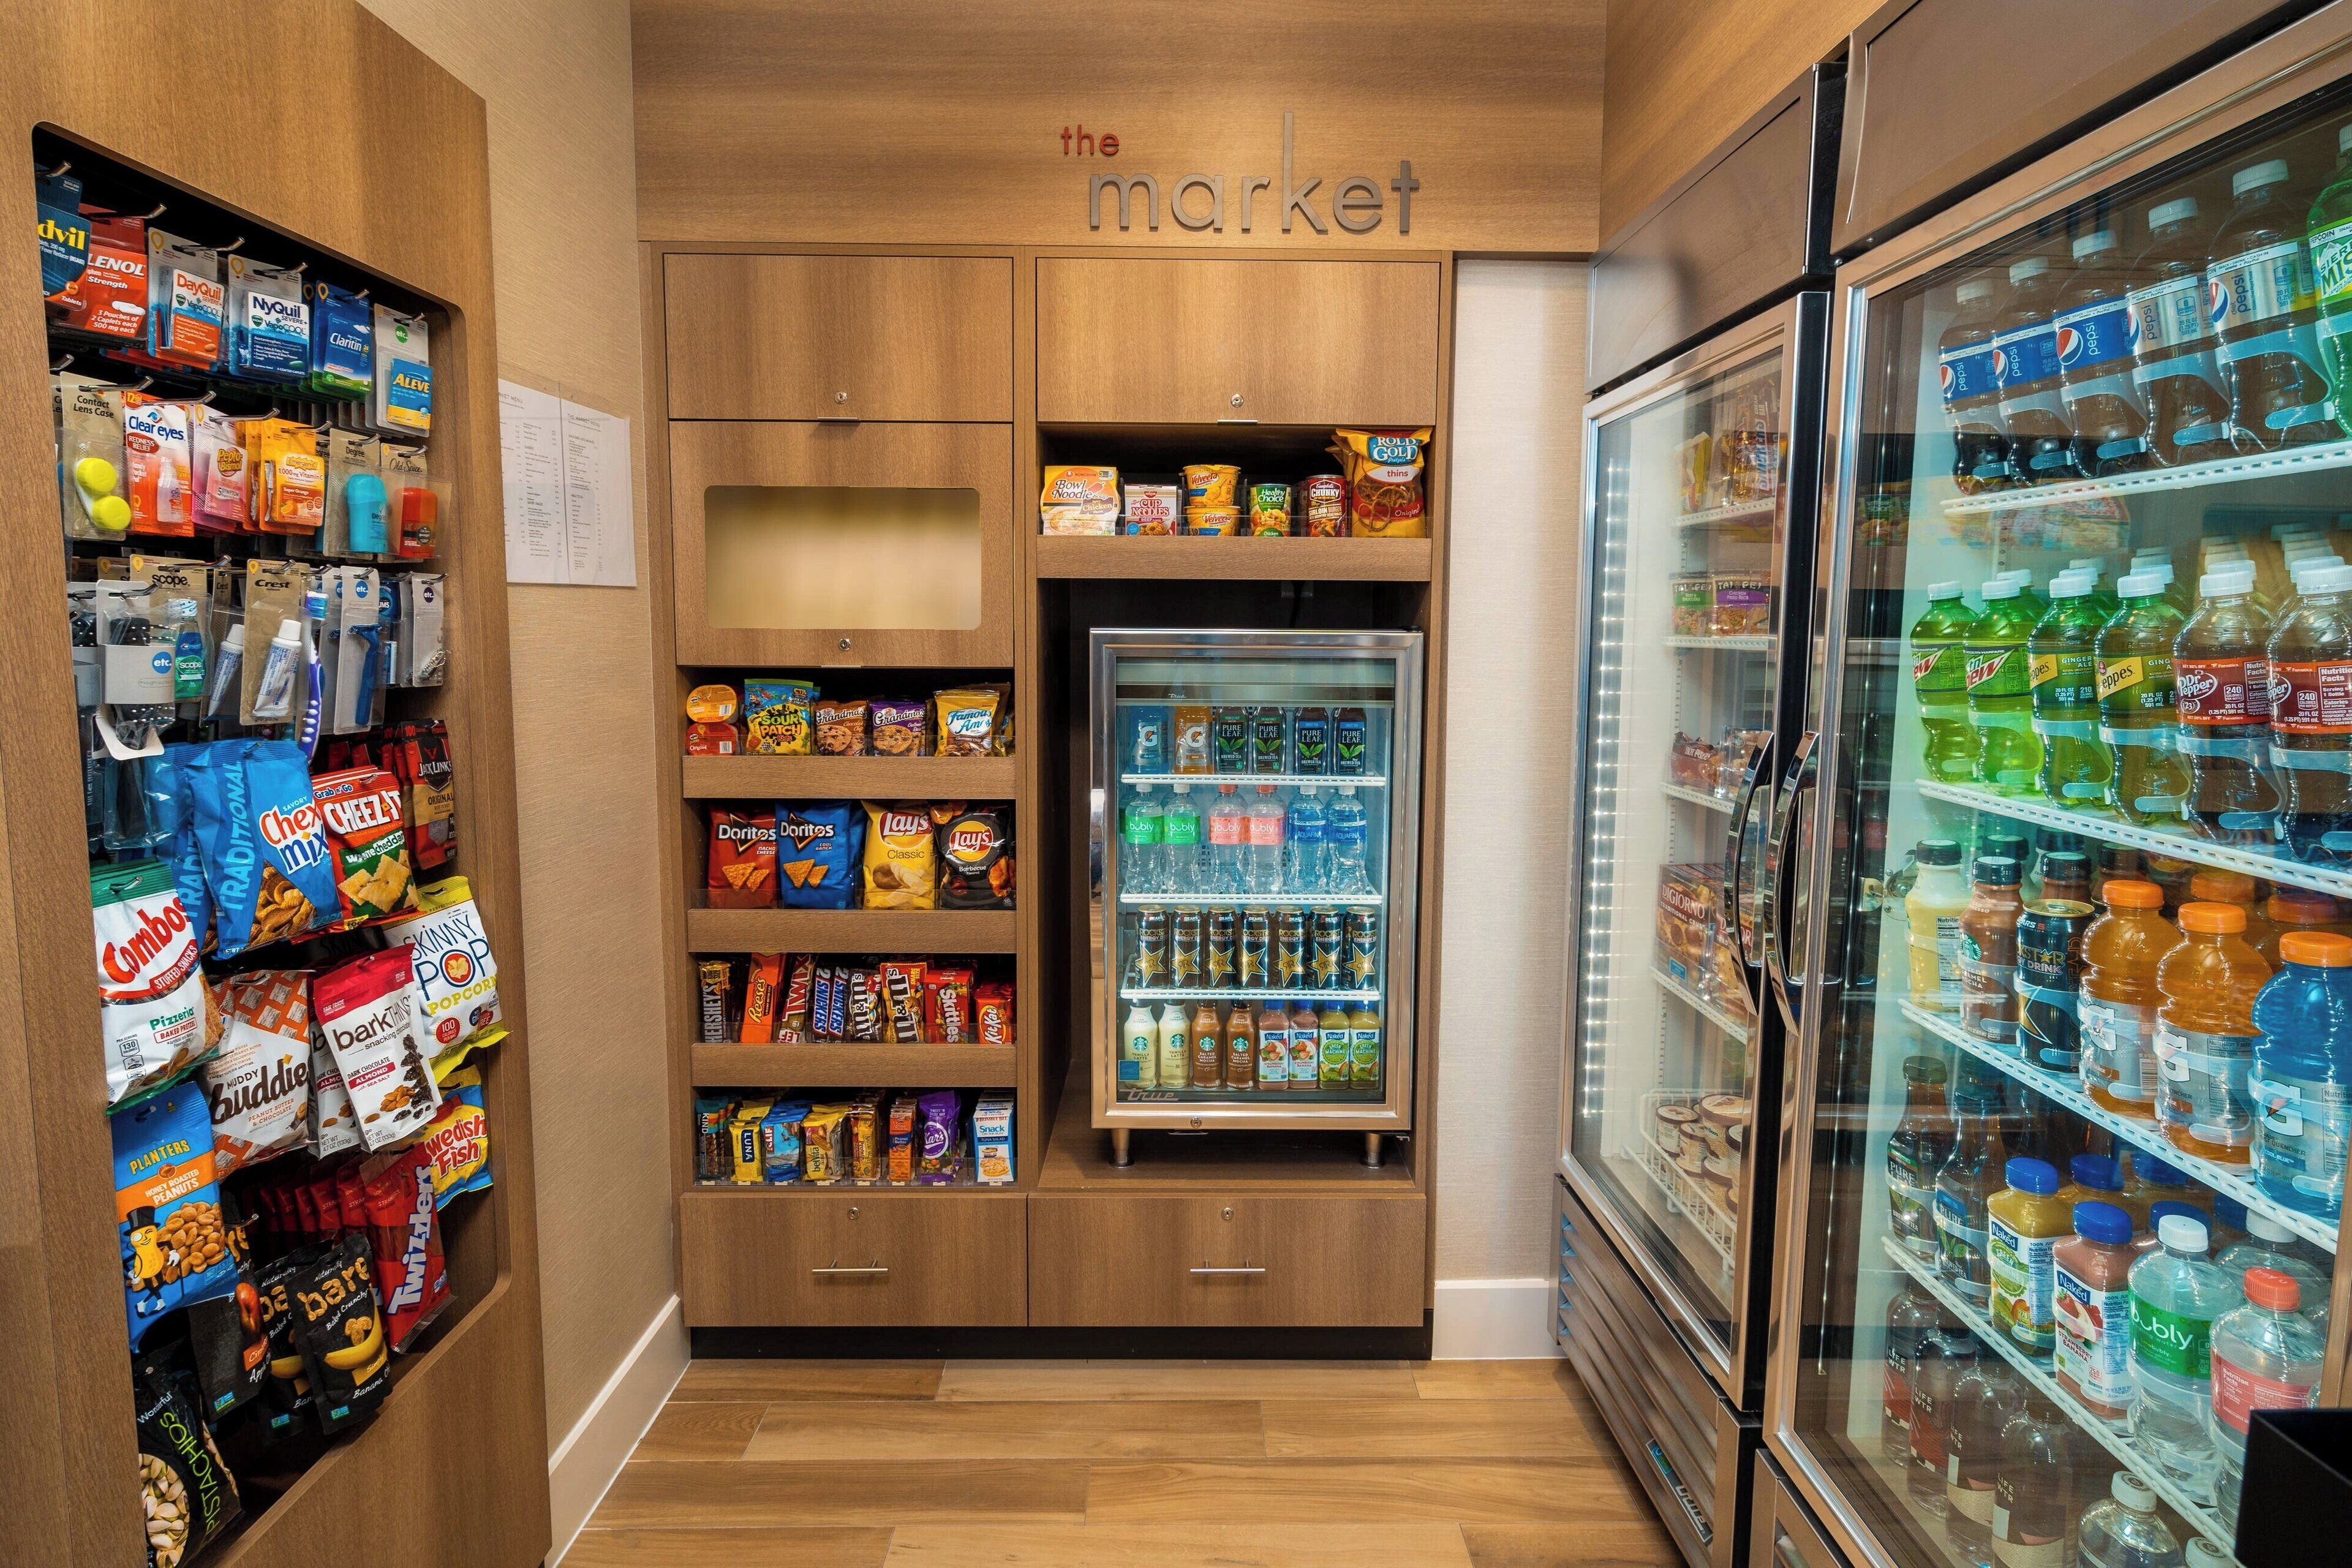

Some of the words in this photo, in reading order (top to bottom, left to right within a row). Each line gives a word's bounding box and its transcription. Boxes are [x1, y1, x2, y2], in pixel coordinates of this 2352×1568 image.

[1061, 124, 1119, 155] the
[1090, 111, 1419, 235] market
[37, 219, 86, 251] dvil
[88, 255, 146, 276] LENOL
[88, 276, 128, 289] Strength
[176, 274, 221, 300] DayQuil
[61, 296, 82, 306] Tablets
[2232, 273, 2252, 314] pepsi
[104, 311, 130, 321] Pouches
[253, 296, 301, 319] NyQuil
[97, 316, 121, 325] Caplets
[2142, 306, 2157, 341] pepsi
[330, 333, 361, 352] Claritin
[2083, 322, 2101, 356] pepsi
[2009, 346, 2022, 377] pepsi
[393, 373, 429, 393] ALEVE
[1959, 361, 1969, 391] pepsi
[74, 403, 92, 415] Lens
[94, 407, 114, 418] Case
[77, 395, 109, 408] Contact
[129, 416, 156, 434] Clear
[157, 427, 184, 440] eyes
[129, 435, 155, 447] REDNESS
[133, 442, 151, 452] RELIEF
[1378, 436, 1416, 447] ROLD
[346, 447, 364, 457] Degree
[1373, 445, 1419, 461] GOLD
[220, 461, 241, 471] Bismol
[1055, 479, 1086, 490] Bowl
[1191, 473, 1218, 485] Velveeta
[1051, 489, 1092, 500] Noodle
[1258, 494, 1284, 503] Choice
[1261, 488, 1286, 497] Healthy
[1311, 488, 1340, 498] CHUNKY
[1082, 503, 1112, 513] Chicken
[1131, 507, 1170, 517] NOODLES
[1139, 499, 1162, 508] CUP
[1204, 513, 1232, 523] Velveeta
[153, 575, 187, 587] scope
[255, 579, 290, 589] Crest
[154, 658, 172, 667] etc.
[2179, 677, 2213, 698] Pepper
[2187, 674, 2201, 685] Dr
[2226, 686, 2242, 695] 240
[2299, 692, 2316, 701] 240
[761, 715, 799, 725] SOUR
[947, 709, 992, 726] Famous
[761, 725, 801, 736] PATCH
[314, 786, 334, 799] Grab
[342, 783, 353, 793] Go
[428, 793, 454, 805] ORIGINAL
[283, 796, 307, 812] SAVORY
[260, 805, 320, 845] Chex
[718, 824, 777, 840] Doritos
[780, 822, 834, 837] Doritos
[883, 813, 929, 837] Lay's
[1129, 822, 1154, 832] bubly
[1170, 822, 1195, 834] bubly
[221, 763, 243, 910] TRADITIONAL
[374, 831, 404, 855] cheddar
[951, 829, 990, 852] Lay's
[279, 832, 329, 870] mix
[888, 850, 924, 859] Classic
[1662, 884, 1705, 919] DIGIORNO
[1660, 902, 1687, 922] TRADITIONAL
[103, 897, 190, 984] Combos
[403, 914, 477, 961] SKINNY
[155, 967, 181, 990] STUFFED
[180, 945, 198, 971] SNACKS
[415, 938, 490, 1001] POP
[2027, 960, 2063, 975] DRINK
[427, 976, 497, 1016] POPCORN
[782, 954, 812, 1022] TWIX
[748, 977, 766, 1023] Reese's
[814, 980, 830, 1033] SNICKERS
[829, 980, 846, 1035] SNICKERS
[150, 1007, 194, 1031] Pizzeria
[703, 984, 723, 1043] HERSHEY'S
[940, 989, 959, 1043] Skittles
[160, 1027, 179, 1039] BAKED
[180, 1020, 195, 1033] PRETZEL
[442, 1020, 455, 1033] 100
[123, 1041, 136, 1050] 130
[365, 1033, 396, 1050] snacking
[347, 1068, 361, 1079] DARK
[361, 1057, 391, 1073] CHOCOLATE
[356, 1066, 388, 1084] ALMOND
[227, 1069, 258, 1090] MUDDY
[210, 1058, 307, 1125] buddie
[248, 1108, 273, 1122] PEANUT
[274, 1098, 295, 1111] BUTTER
[258, 1105, 292, 1124] CHOCOLATE
[427, 1115, 486, 1159] wedish
[742, 1133, 753, 1161] LUNA
[129, 1140, 190, 1175] PLANTERS
[2272, 1140, 2306, 1156] QUENCHER
[435, 1140, 479, 1178] Fish
[1890, 1161, 1915, 1183] PURE
[145, 1182, 168, 1197] HONEY
[168, 1169, 199, 1188] ROASTED
[153, 1178, 199, 1205] PEANUTS
[387, 1165, 433, 1314] Twizzlers
[1992, 1223, 2016, 1249] Naked
[297, 1257, 369, 1321] bare
[2059, 1273, 2089, 1303] Naked
[326, 1308, 342, 1331] Baked
[341, 1289, 368, 1313] Crunchy
[2058, 1330, 2093, 1362] STRAWBERRY
[2062, 1340, 2089, 1363] BANANA
[1888, 1356, 1905, 1374] WTR
[1889, 1349, 1905, 1366] LIFE
[2223, 1367, 2249, 1386] Nutrition
[353, 1378, 383, 1399] Banana
[1915, 1387, 1932, 1404] LIFE
[1915, 1396, 1932, 1414] WTR
[160, 1412, 221, 1533] PISTACHIOS
[1997, 1472, 2014, 1493] LIFE
[1997, 1483, 2014, 1504] WTR
